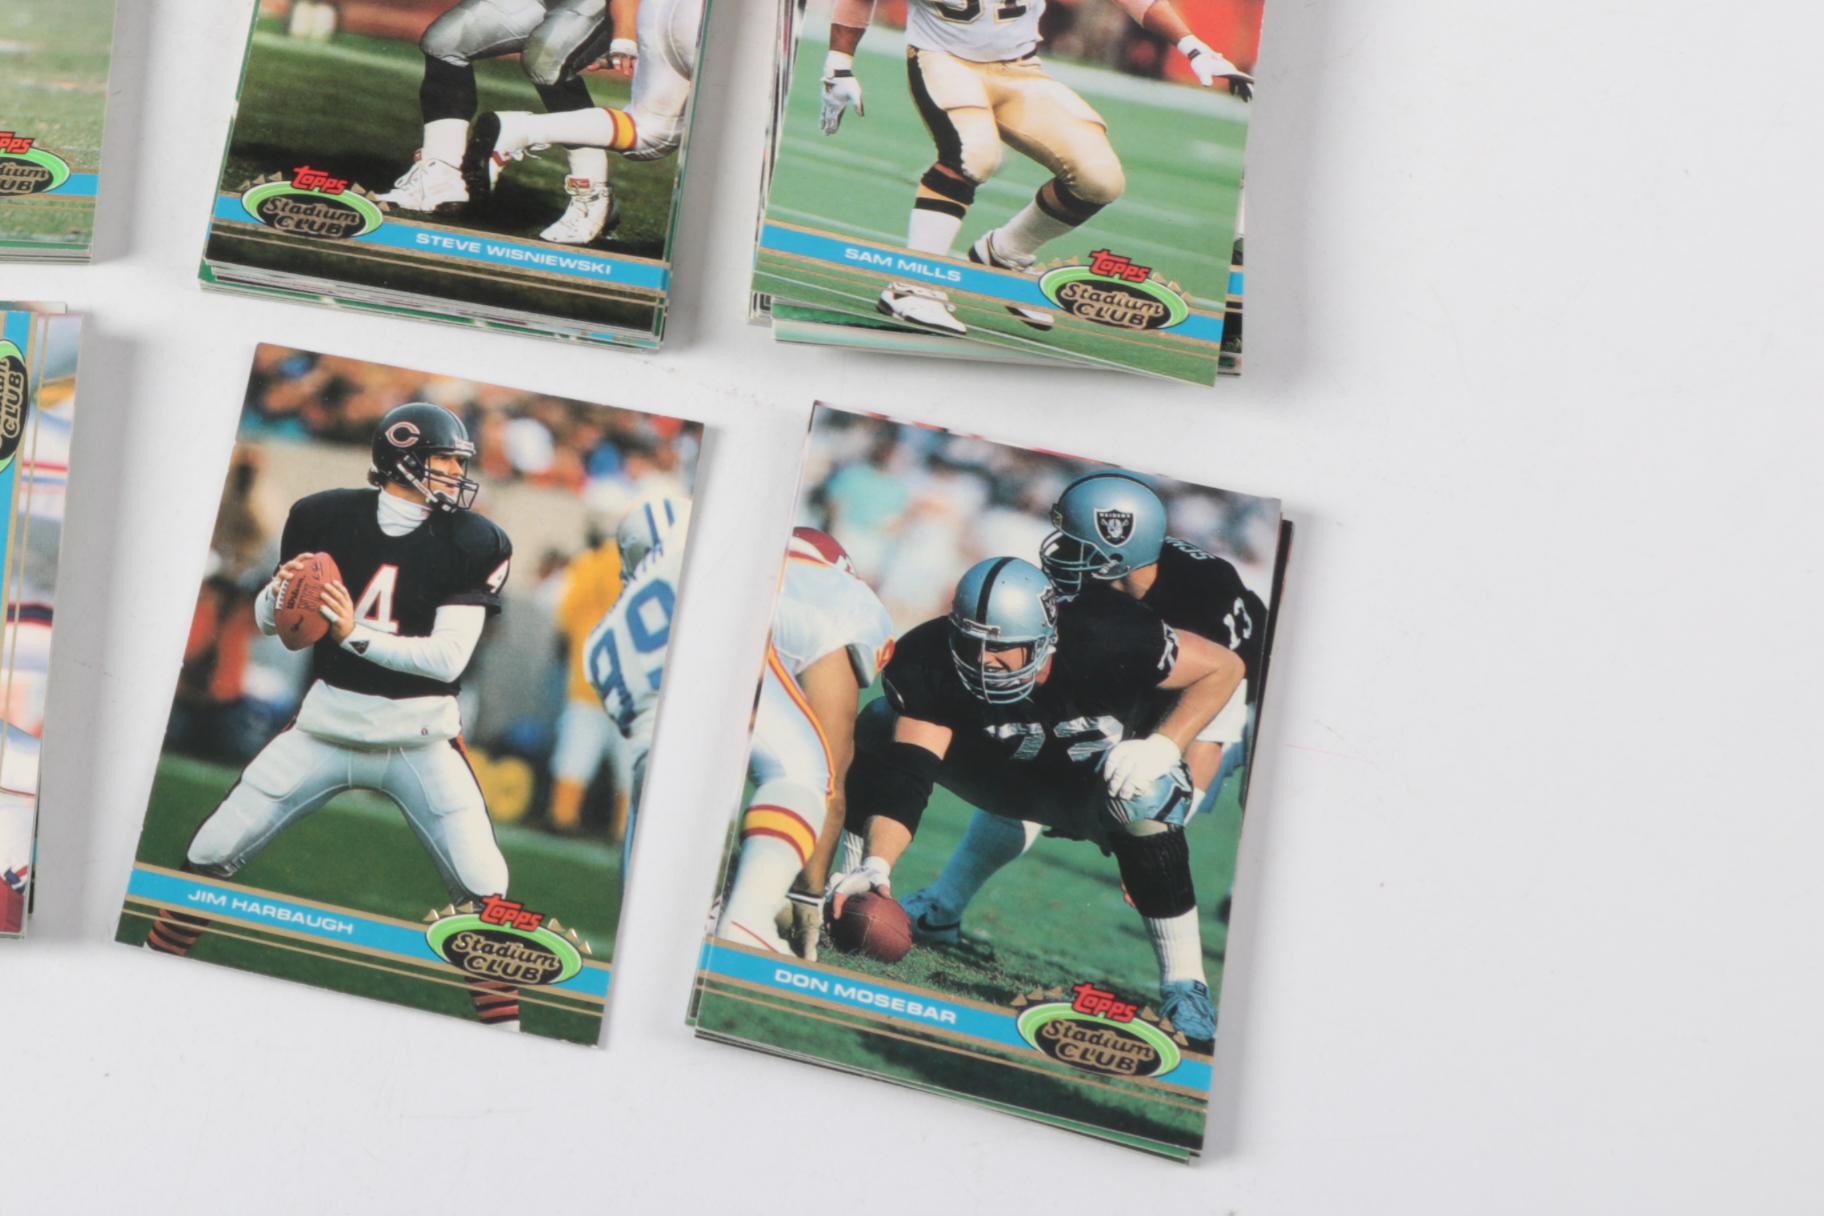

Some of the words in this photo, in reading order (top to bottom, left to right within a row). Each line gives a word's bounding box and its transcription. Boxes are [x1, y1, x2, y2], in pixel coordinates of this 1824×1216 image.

[263, 196, 360, 225] Stadium
[274, 215, 345, 237] CLUB
[416, 233, 482, 254] STEVE
[486, 244, 612, 275] WISNIEWSKI
[844, 247, 893, 268] SAM
[897, 259, 962, 282] MILLS
[1061, 282, 1164, 317] Stadium
[1074, 300, 1147, 330] CLUB
[3, 371, 25, 439] CLUB
[356, 564, 400, 635] 4
[187, 889, 227, 906] JIM
[231, 897, 355, 935] HARBAUGH
[452, 932, 561, 970] Stadium
[464, 954, 545, 984] CLUB
[774, 968, 829, 993] DON
[833, 983, 958, 1025] MOSEBAR
[1042, 1018, 1156, 1062] Stadium
[1055, 1041, 1139, 1075] CLUB
